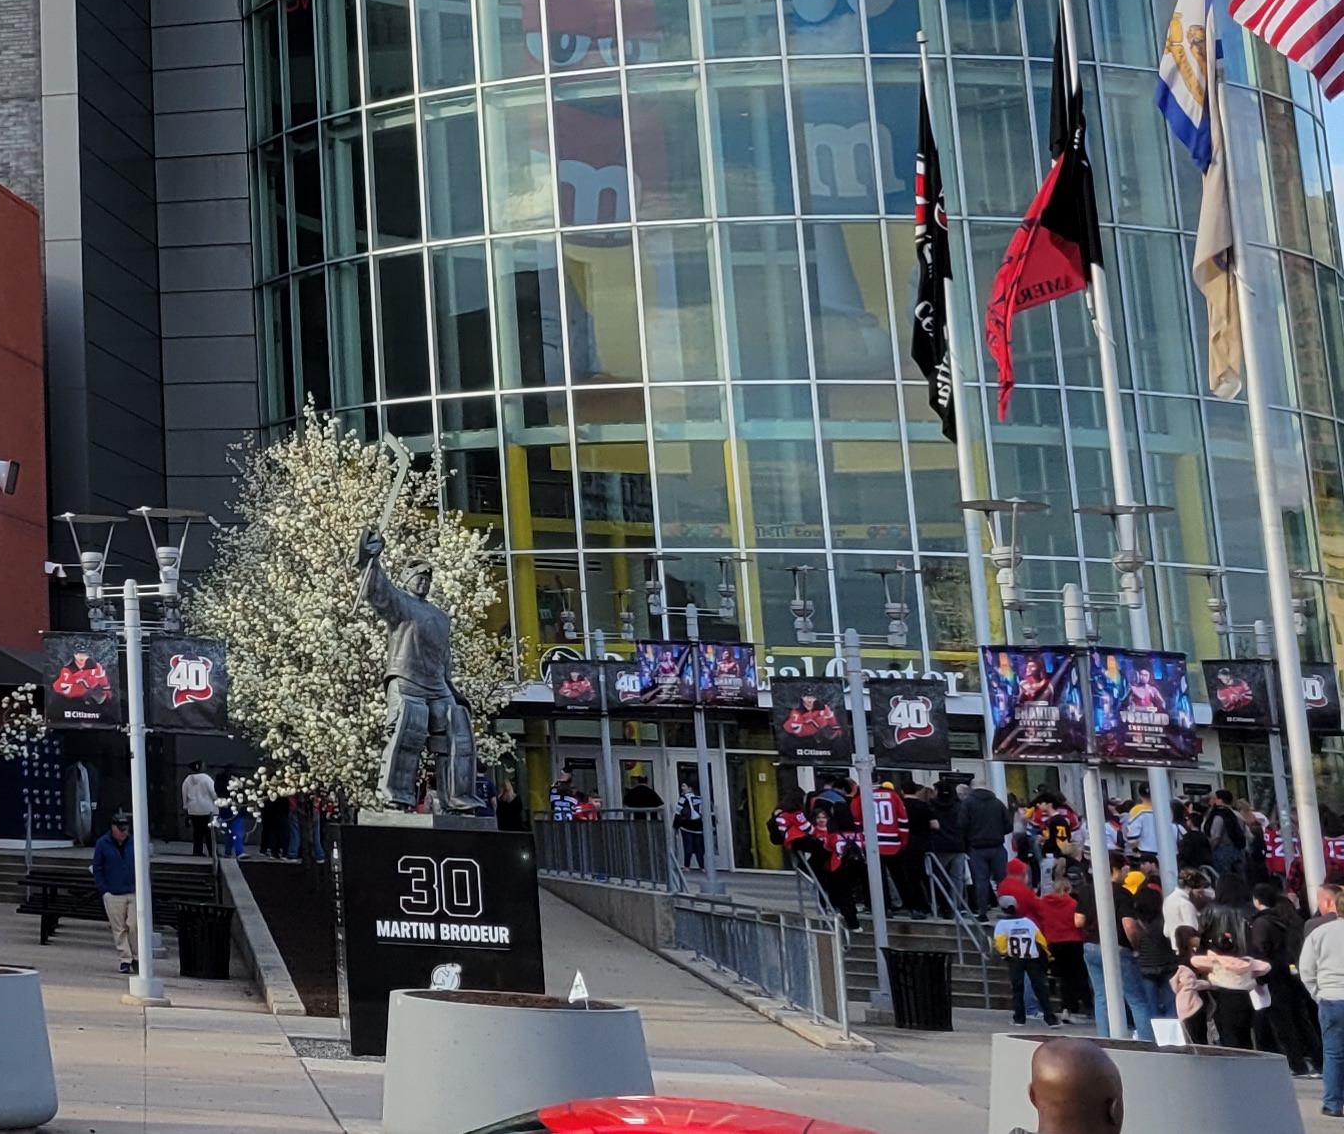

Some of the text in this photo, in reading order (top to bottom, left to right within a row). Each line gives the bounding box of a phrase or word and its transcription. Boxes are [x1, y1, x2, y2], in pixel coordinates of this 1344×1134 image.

[168, 661, 209, 691] 40
[72, 711, 100, 719] Citizens
[889, 702, 930, 728] 40
[398, 855, 483, 918] 30
[376, 920, 510, 943] MARTIN BRODEUR
[1009, 937, 1032, 958] 87
